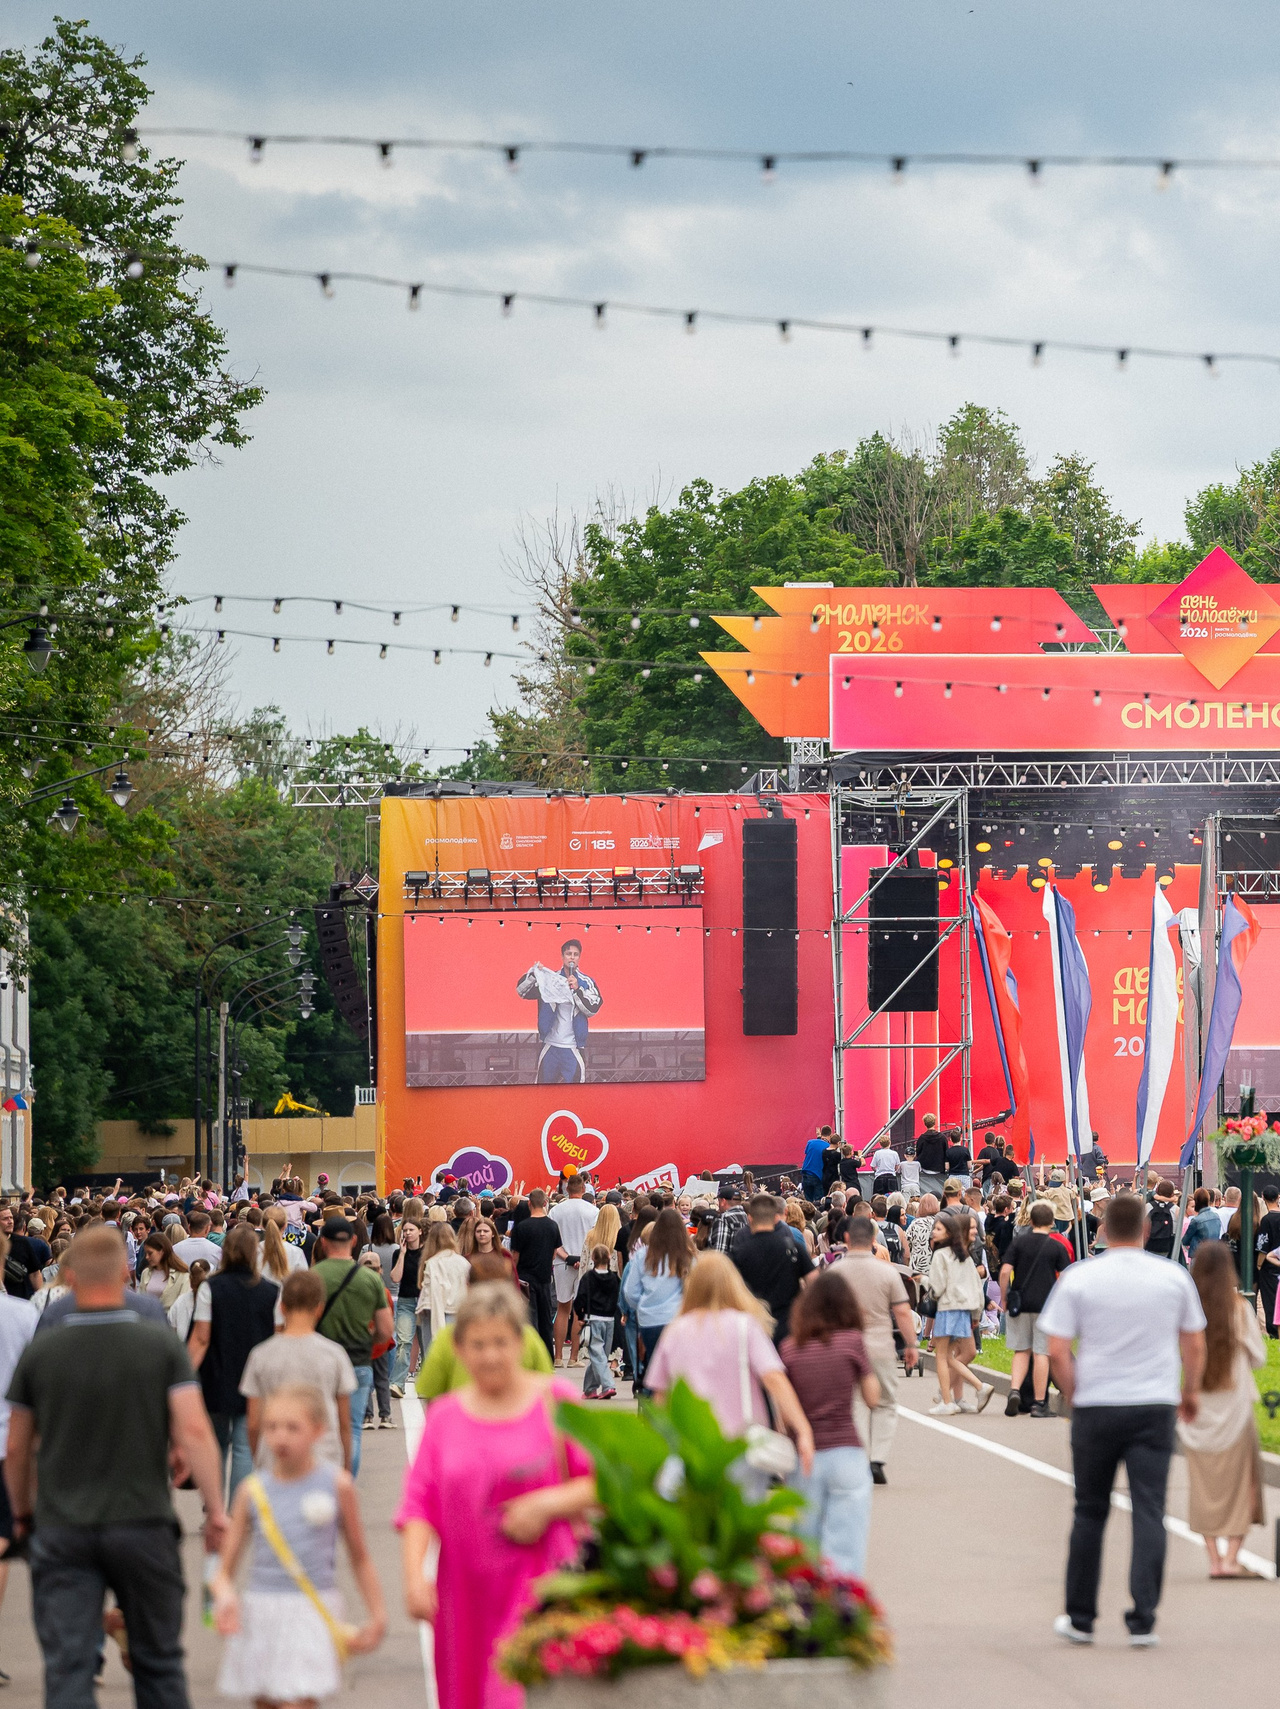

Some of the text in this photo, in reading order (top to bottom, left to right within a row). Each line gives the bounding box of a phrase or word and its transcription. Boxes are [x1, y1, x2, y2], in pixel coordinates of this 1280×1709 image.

[1180, 595, 1218, 609] ДЕНЬ
[811, 603, 929, 625] СМОЛЕНСК
[1180, 607, 1258, 623] МОЛОДЁЖИ
[837, 630, 904, 652] 2026
[1180, 627, 1208, 638] 2026
[590, 839, 615, 850] 185
[630, 839, 649, 847] 2026
[1113, 1036, 1144, 1057] 20
[552, 1134, 588, 1161] ЛЮБИ
[463, 1164, 495, 1189] ТАЙ
